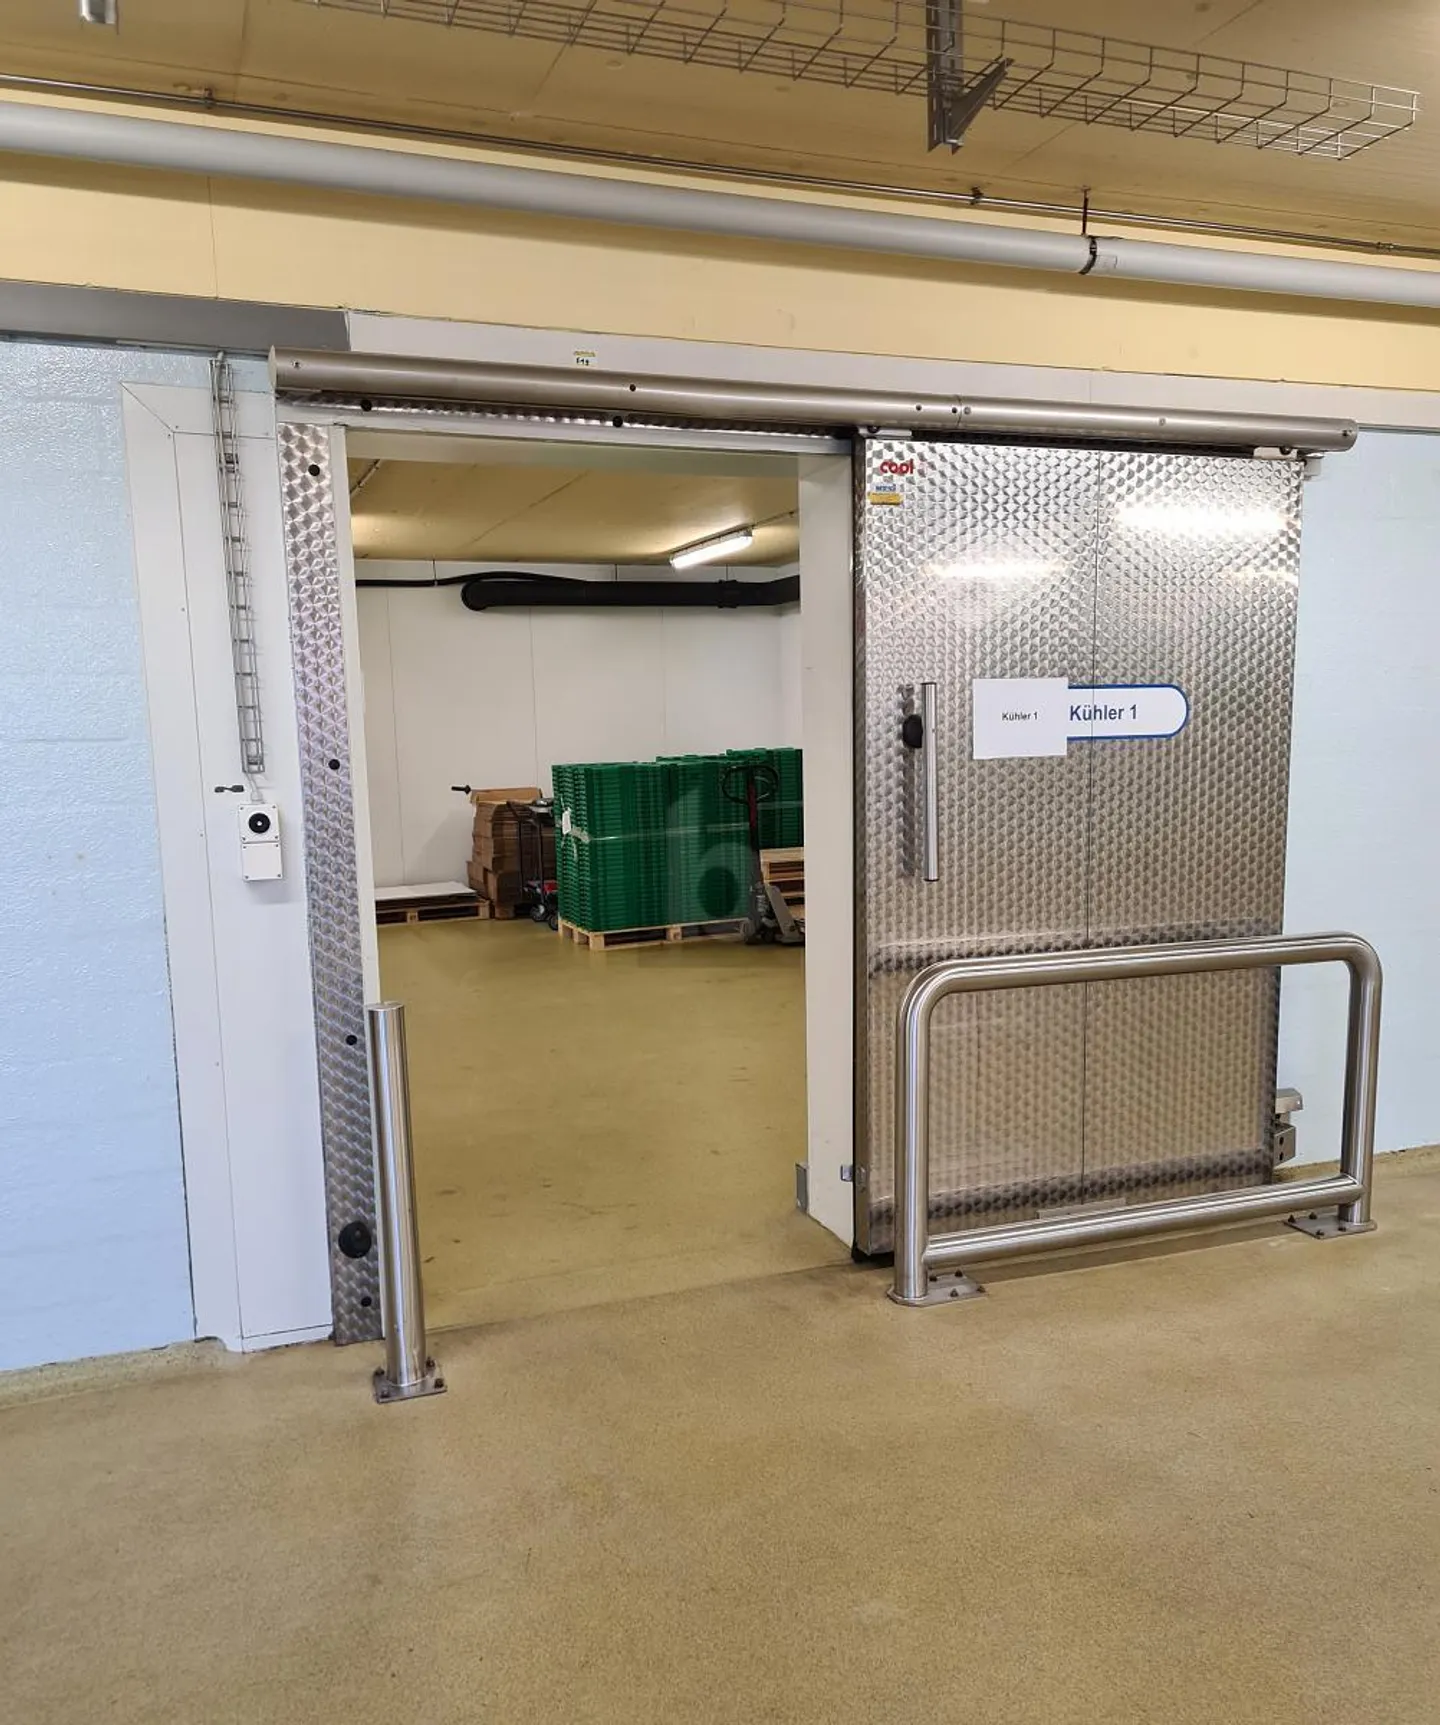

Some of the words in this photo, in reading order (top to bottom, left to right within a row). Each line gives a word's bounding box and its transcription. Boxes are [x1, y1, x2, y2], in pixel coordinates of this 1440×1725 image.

[1001, 711, 1031, 721] Kühler
[1033, 711, 1038, 720] 1
[1069, 704, 1125, 722] Kühler
[1129, 704, 1137, 720] 1
